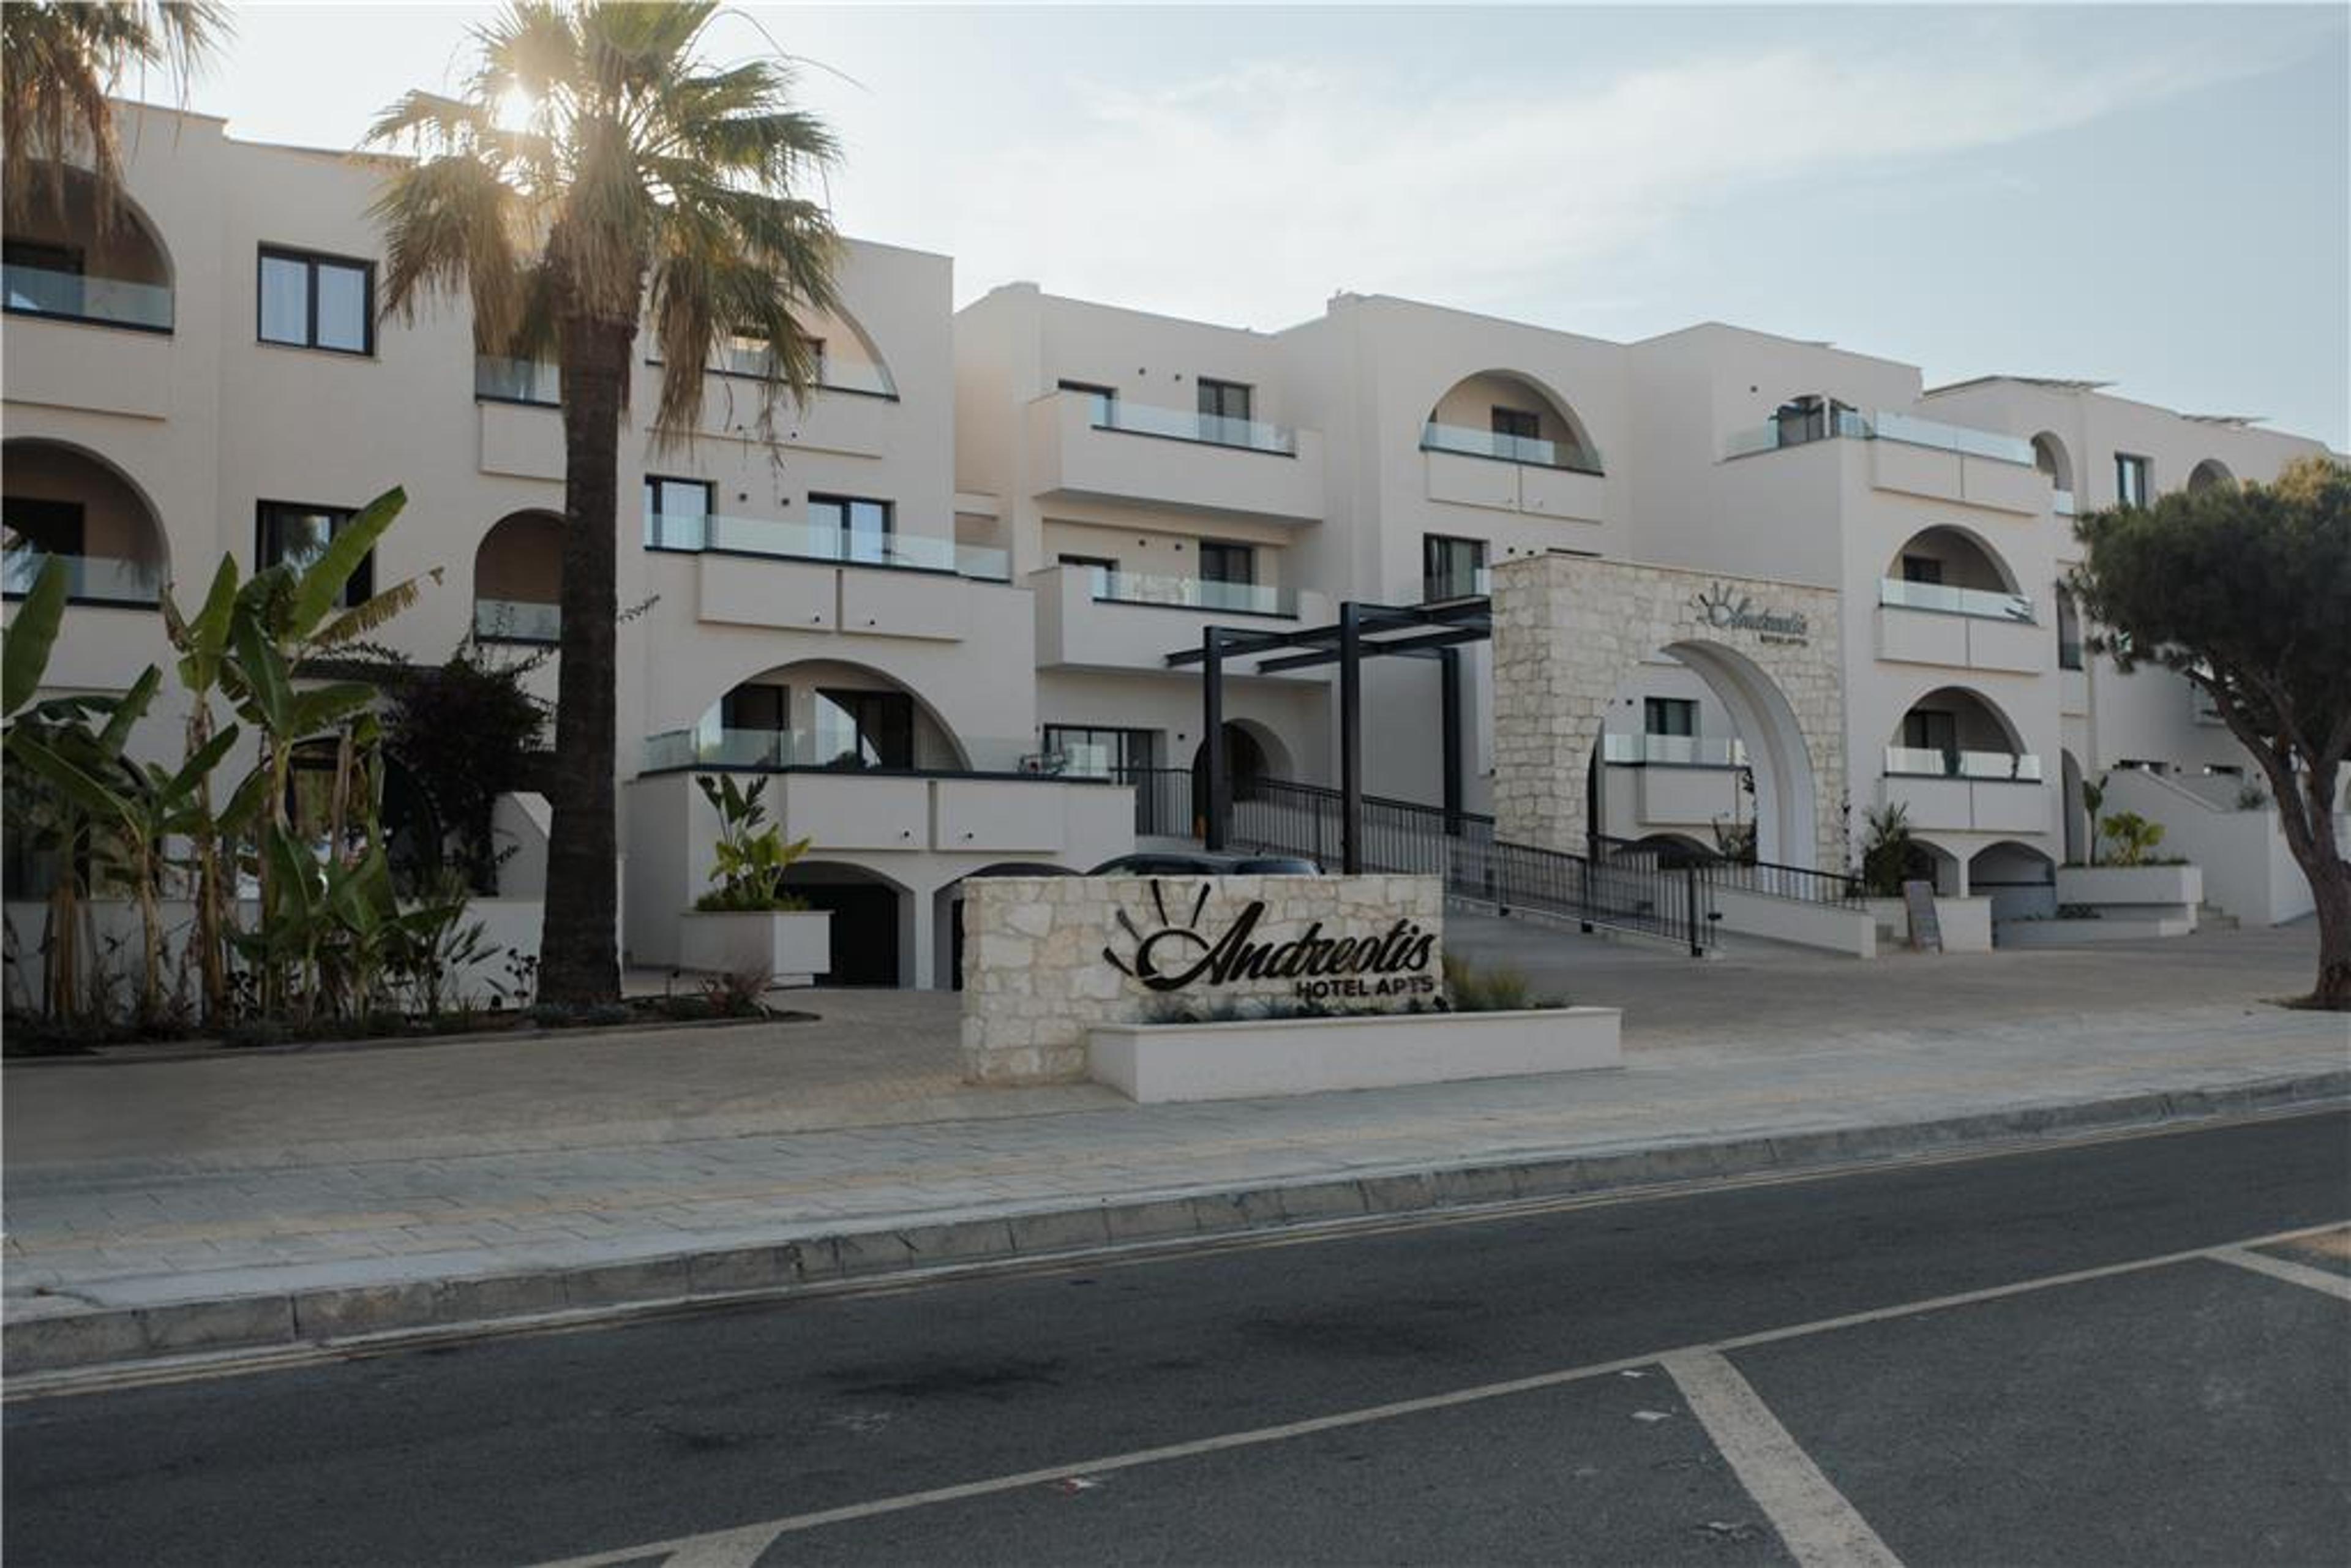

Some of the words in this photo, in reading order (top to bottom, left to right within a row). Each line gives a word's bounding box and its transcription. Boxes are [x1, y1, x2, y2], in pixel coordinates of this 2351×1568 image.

[1136, 902, 1436, 991] Andreotis
[1295, 980, 1370, 999] HOTEL
[1376, 975, 1434, 995] APTS
